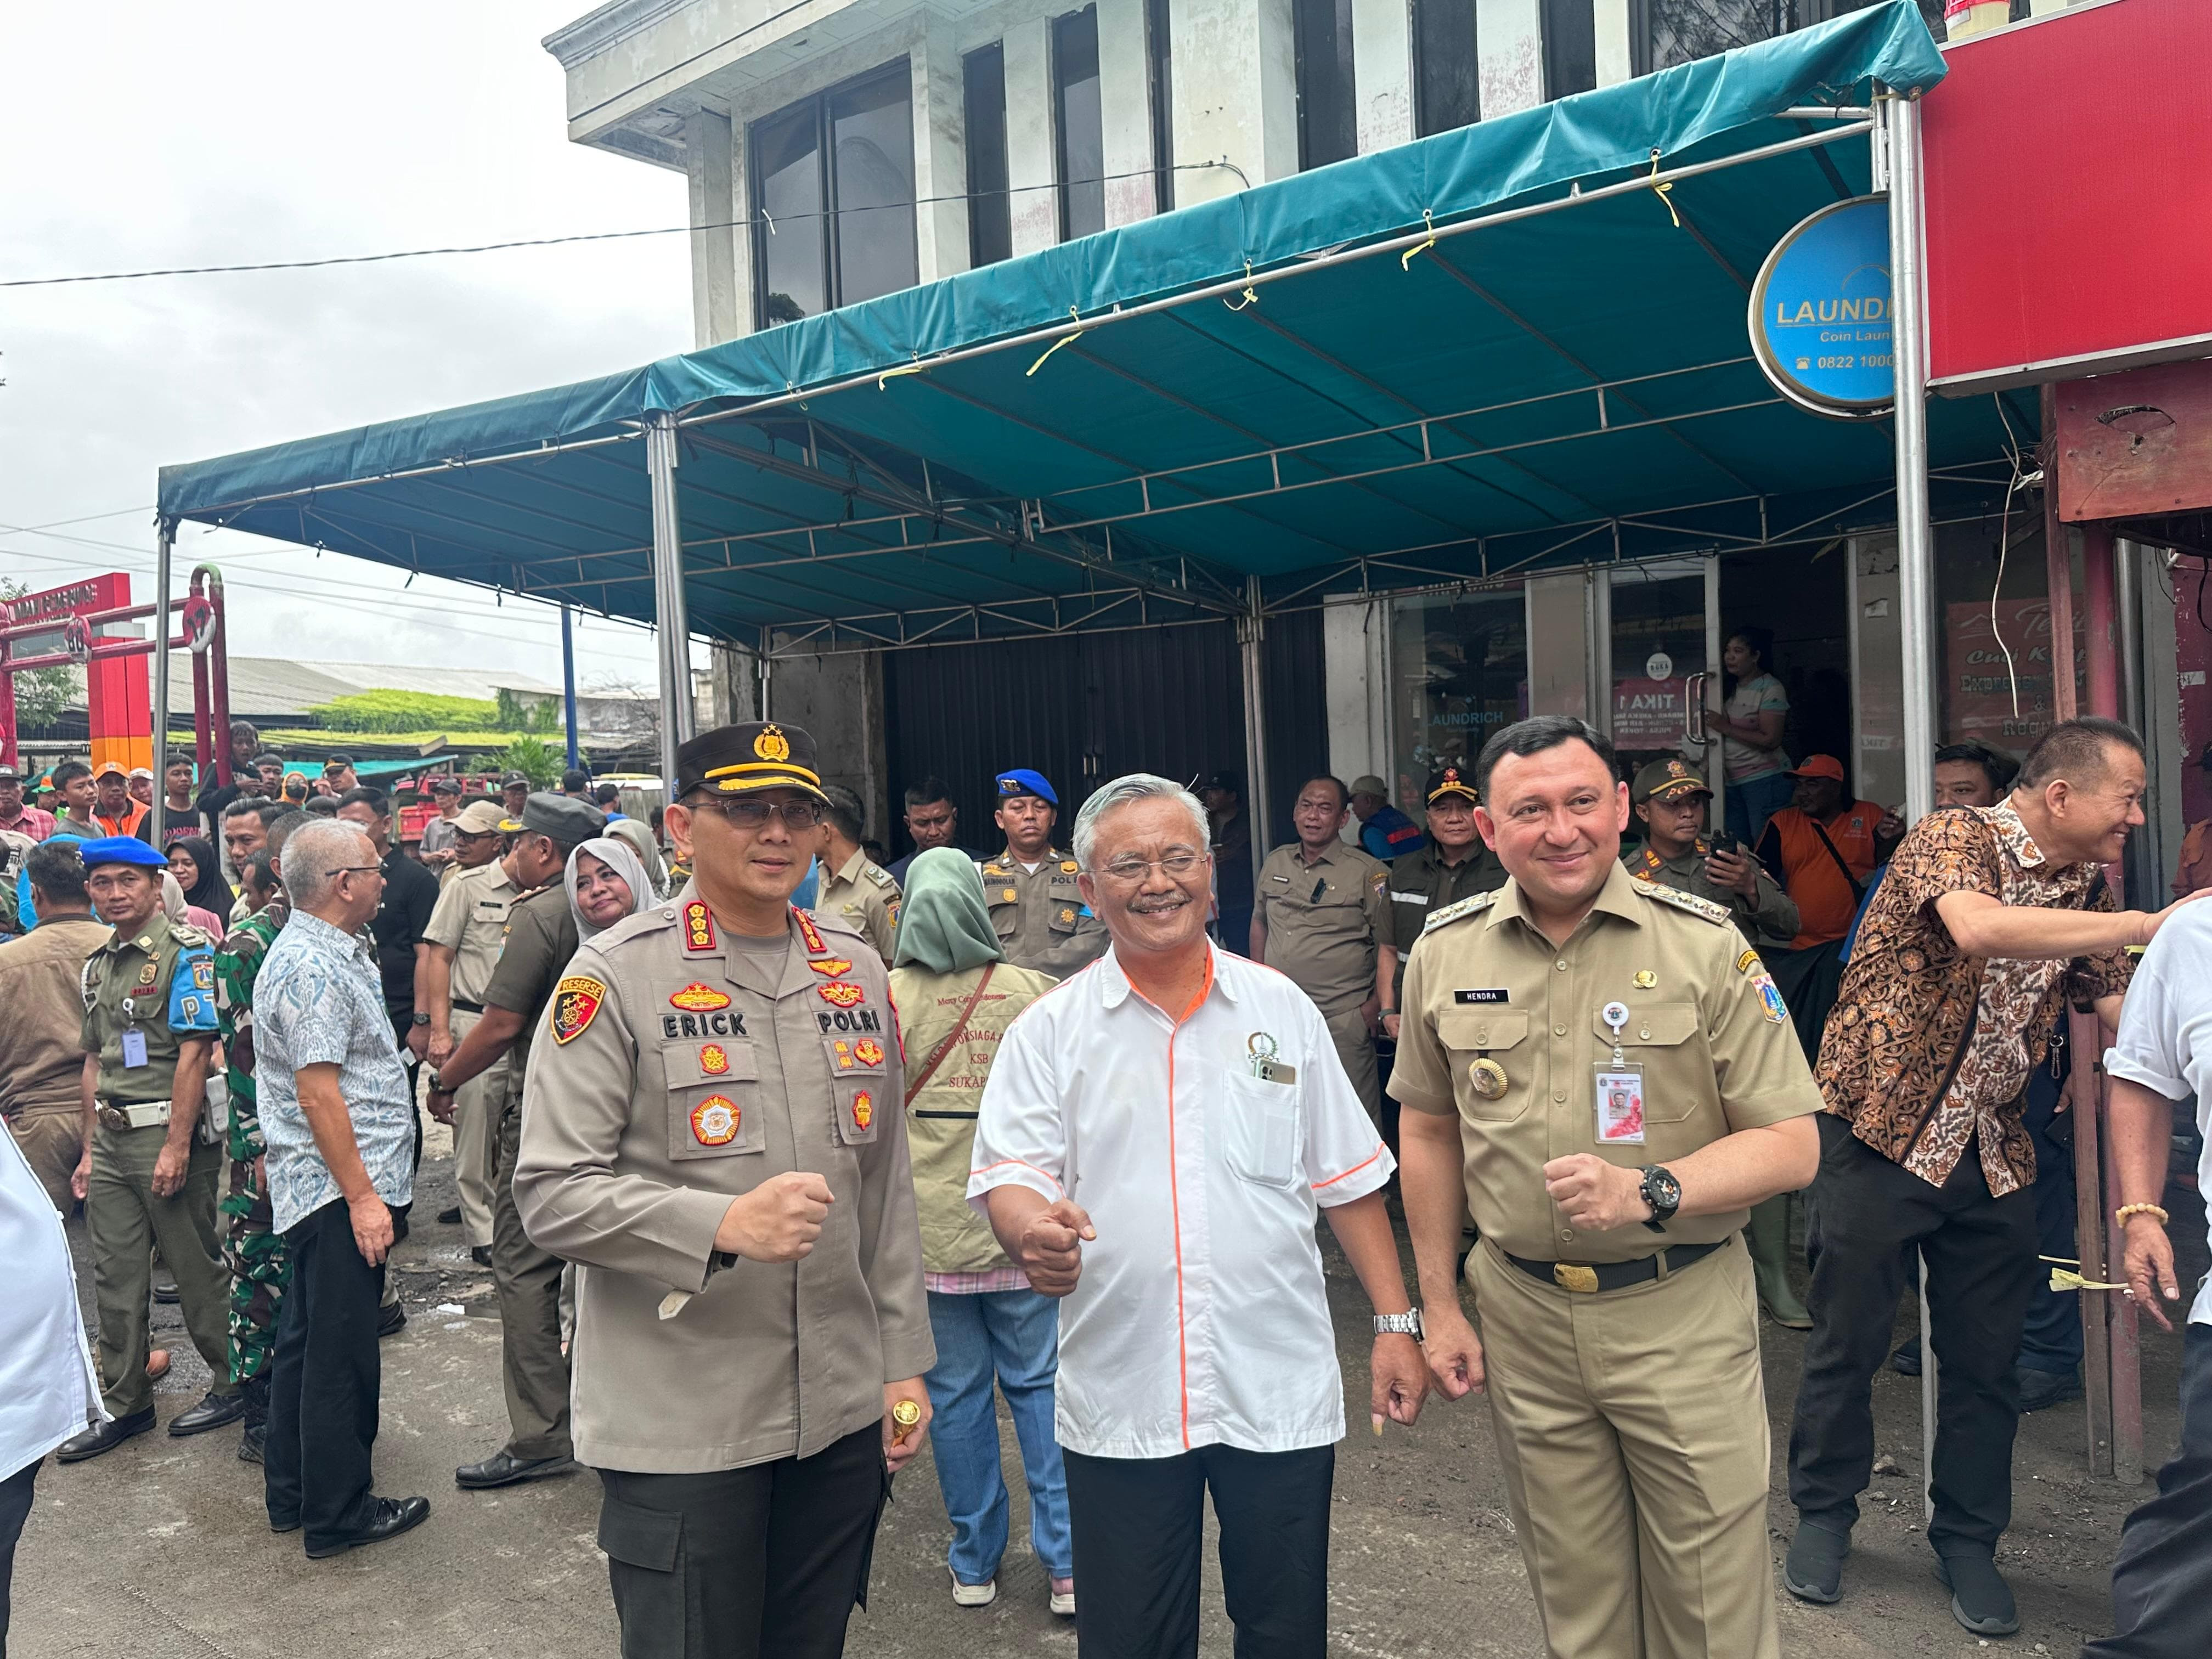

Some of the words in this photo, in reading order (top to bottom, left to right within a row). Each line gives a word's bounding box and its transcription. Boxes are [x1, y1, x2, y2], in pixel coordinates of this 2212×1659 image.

[1820, 331, 1852, 342] Coin
[1857, 330, 1892, 341] Laun
[1818, 356, 1854, 369] 0822
[562, 979, 602, 996] RESERSE
[1466, 992, 1497, 1000] HENDRA
[663, 1013, 747, 1037] ERICK
[818, 1009, 881, 1033] POLRI
[970, 1053, 989, 1064] KSB
[949, 1076, 988, 1088] SUKAP
